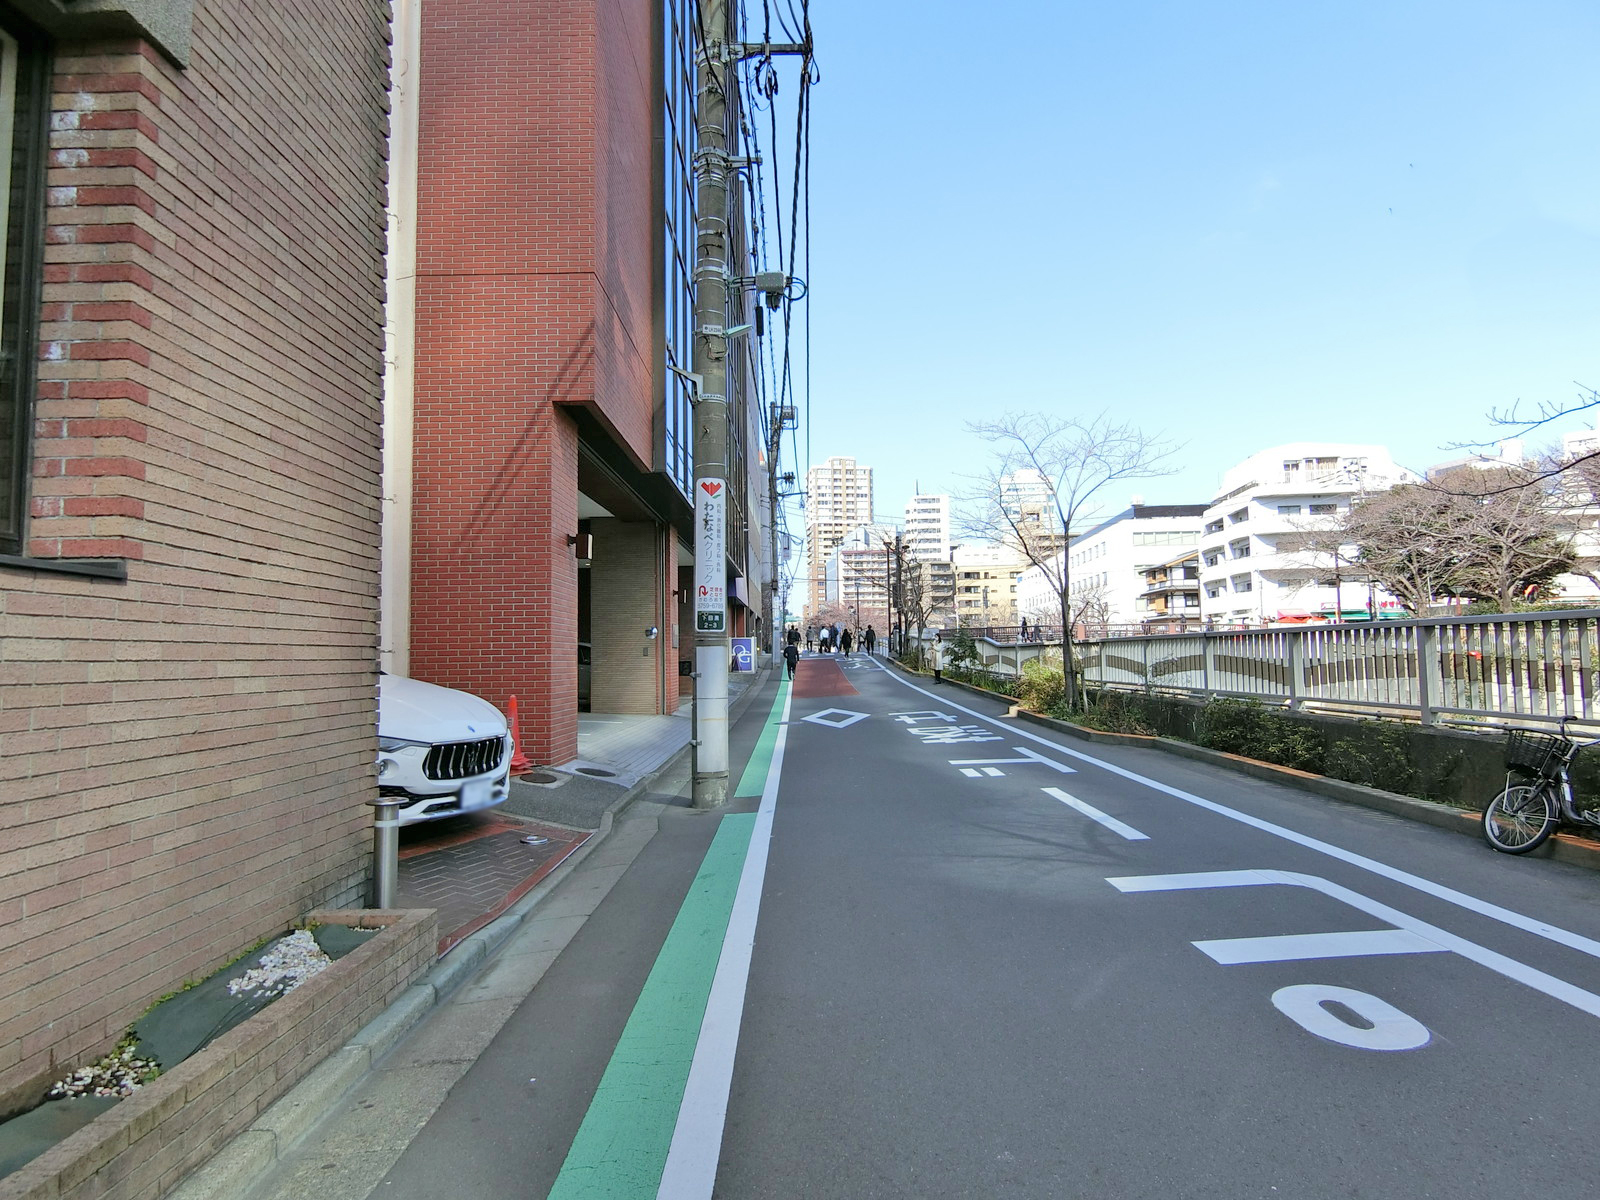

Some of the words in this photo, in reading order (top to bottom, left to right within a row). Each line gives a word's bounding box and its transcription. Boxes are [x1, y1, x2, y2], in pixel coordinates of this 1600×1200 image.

[703, 501, 714, 583] わたなべクリニック
